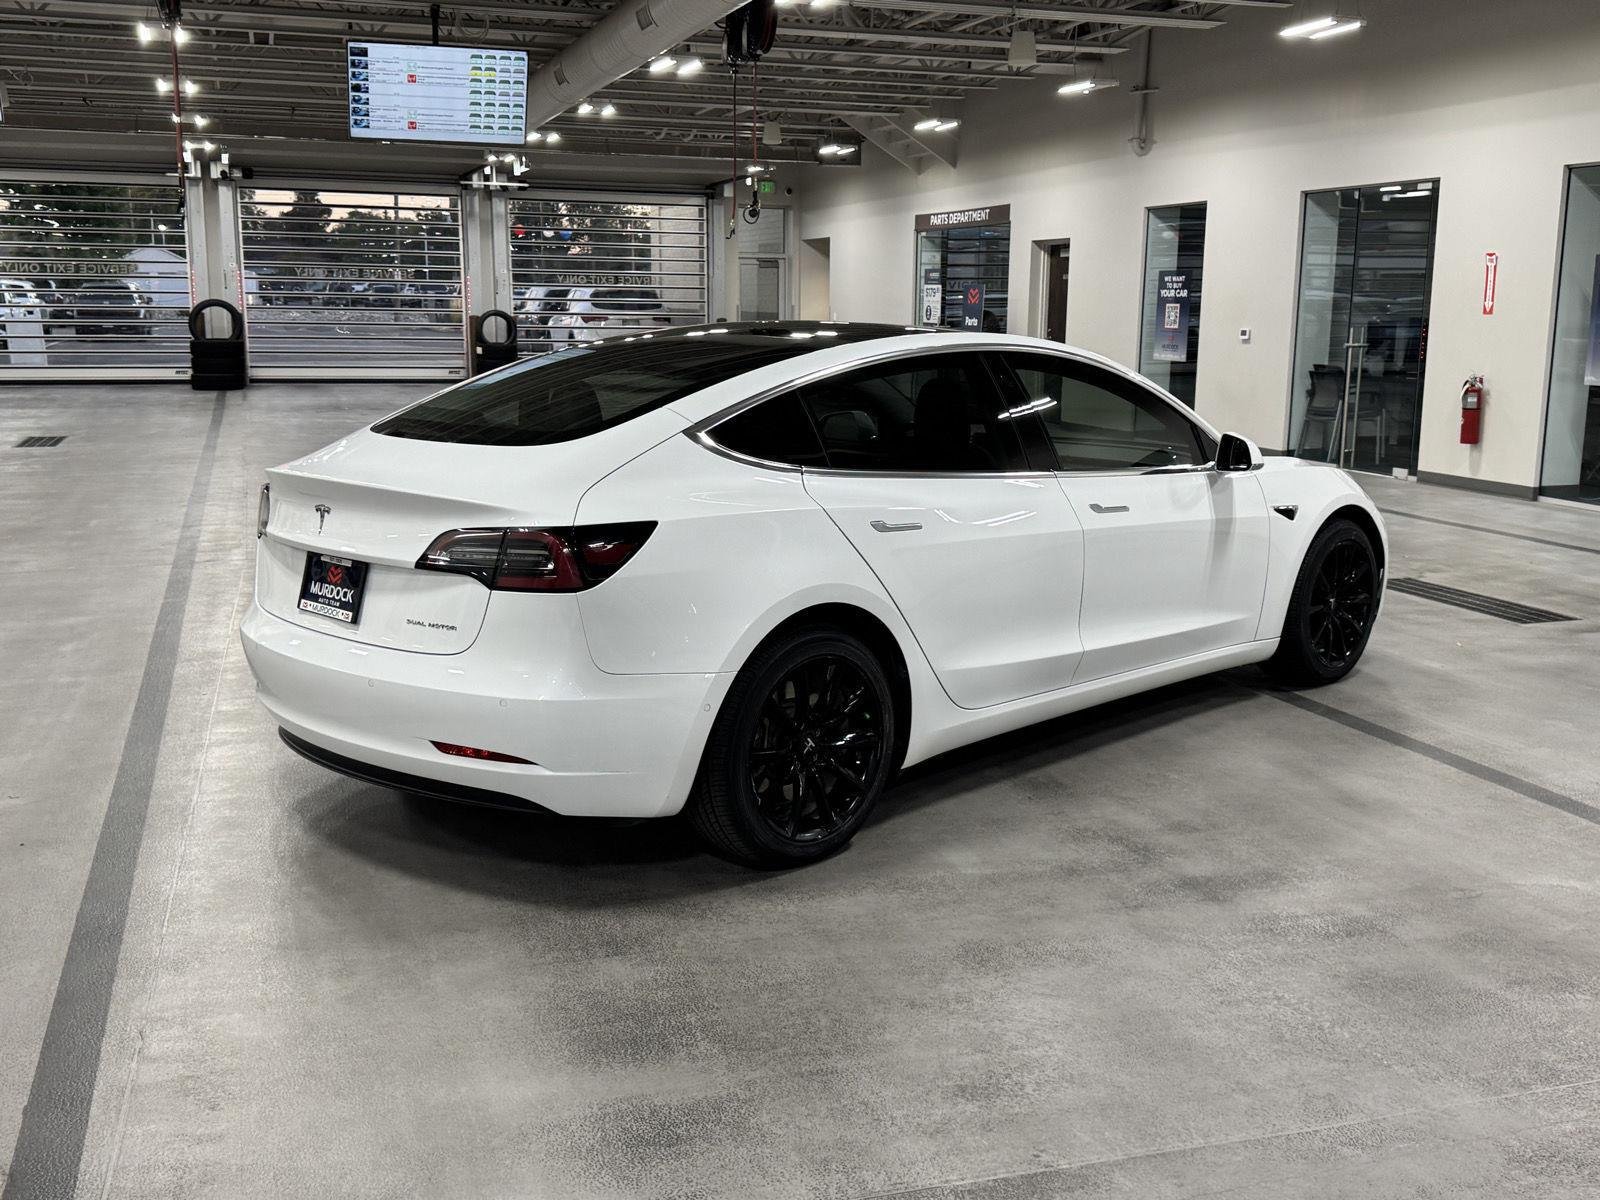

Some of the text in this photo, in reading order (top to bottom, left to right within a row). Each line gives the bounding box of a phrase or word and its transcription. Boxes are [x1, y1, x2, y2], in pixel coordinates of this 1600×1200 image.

[760, 181, 775, 193] EXIT
[930, 209, 990, 226] PARTS DEPARTMENT
[1160, 289, 1188, 298] YOUR CAR
[964, 316, 978, 327] Parts
[310, 580, 354, 604] MURDOCK
[311, 603, 341, 617] MURDOCK
[406, 618, 458, 631] DUAL MOTOR
